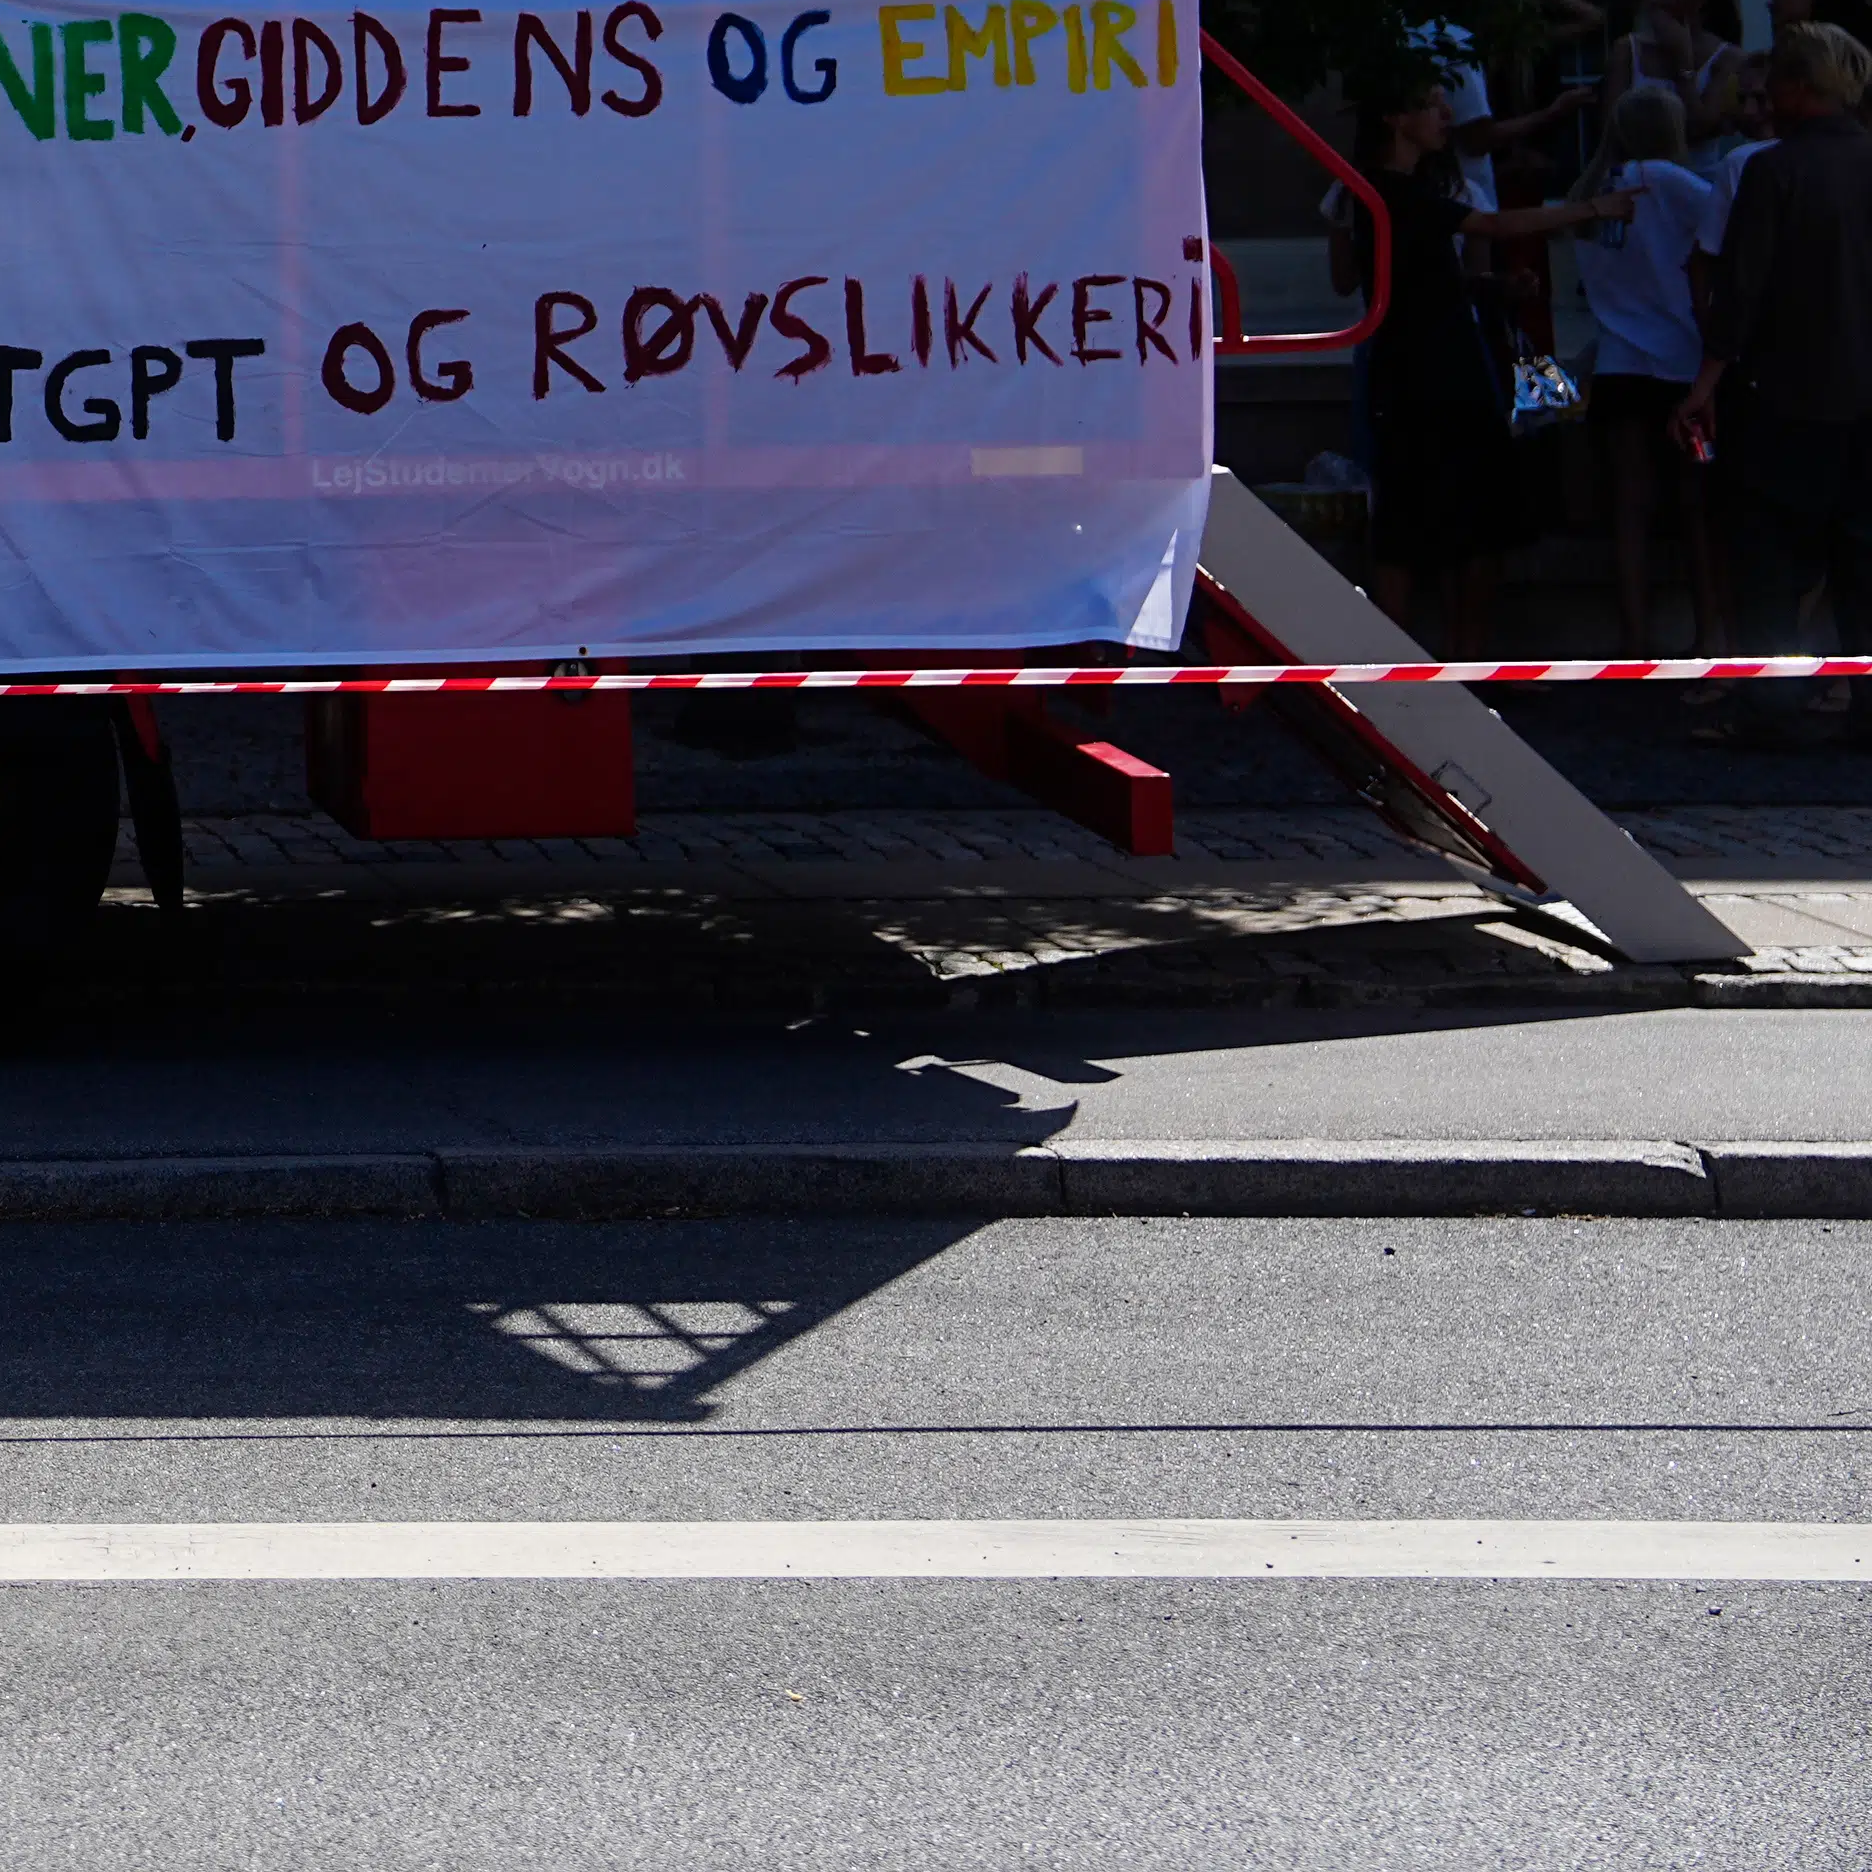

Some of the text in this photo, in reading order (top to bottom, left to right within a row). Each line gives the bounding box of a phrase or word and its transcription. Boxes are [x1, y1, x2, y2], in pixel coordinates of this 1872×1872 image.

[197, 0, 664, 129] GIDDENS
[706, 9, 837, 105] OG
[321, 308, 473, 415] OG
